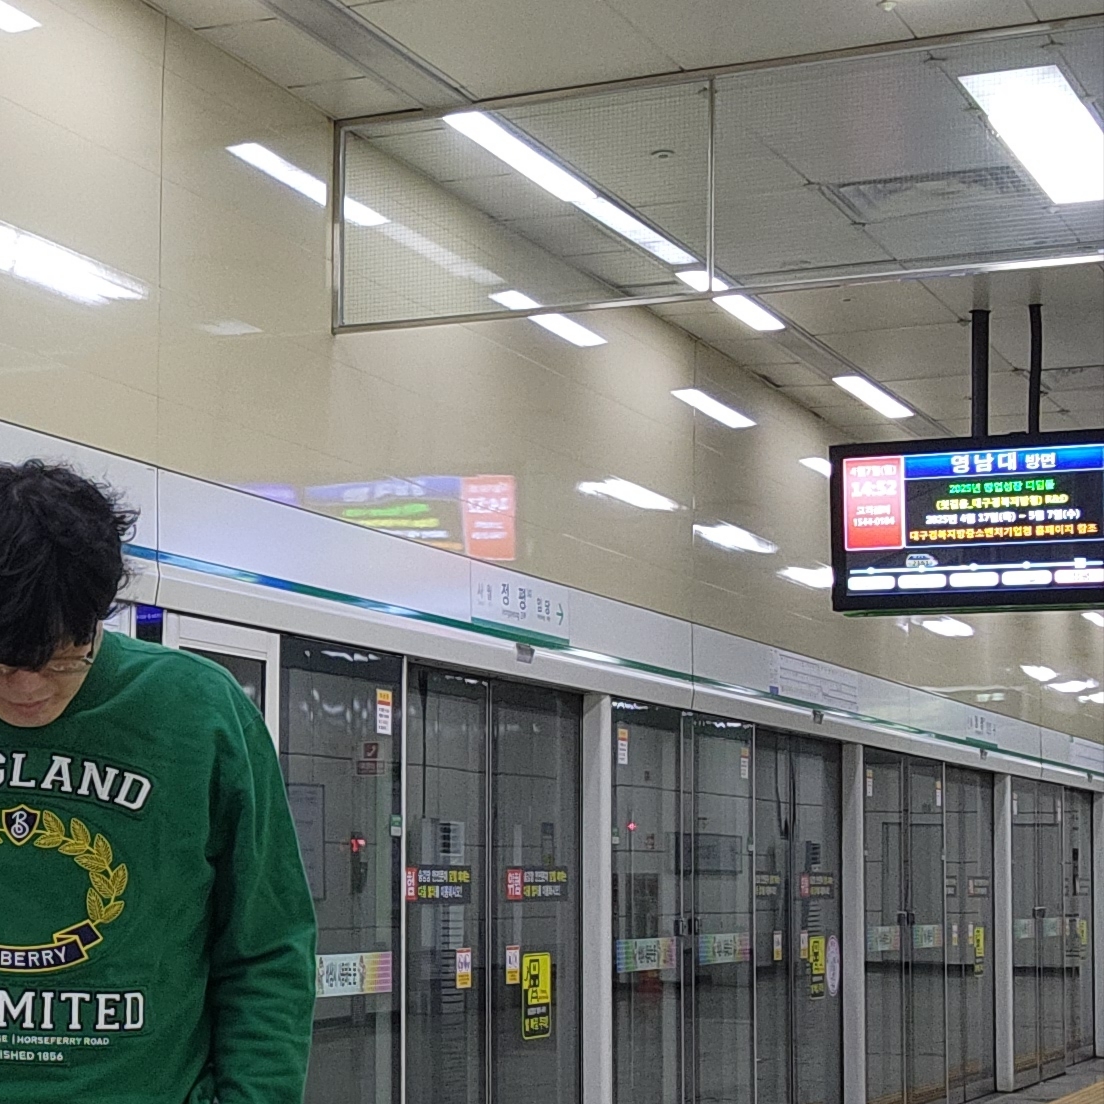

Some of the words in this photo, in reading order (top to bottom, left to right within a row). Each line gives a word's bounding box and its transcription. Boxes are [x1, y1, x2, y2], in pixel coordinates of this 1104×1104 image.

[951, 452, 1017, 473] 영남대
[1025, 452, 1057, 469] 방면
[949, 482, 981, 494] 2025년
[17, 1035, 82, 1046] HORSEFERRY
[83, 1036, 110, 1046] ROAD
[37, 1051, 64, 1062] 1856
